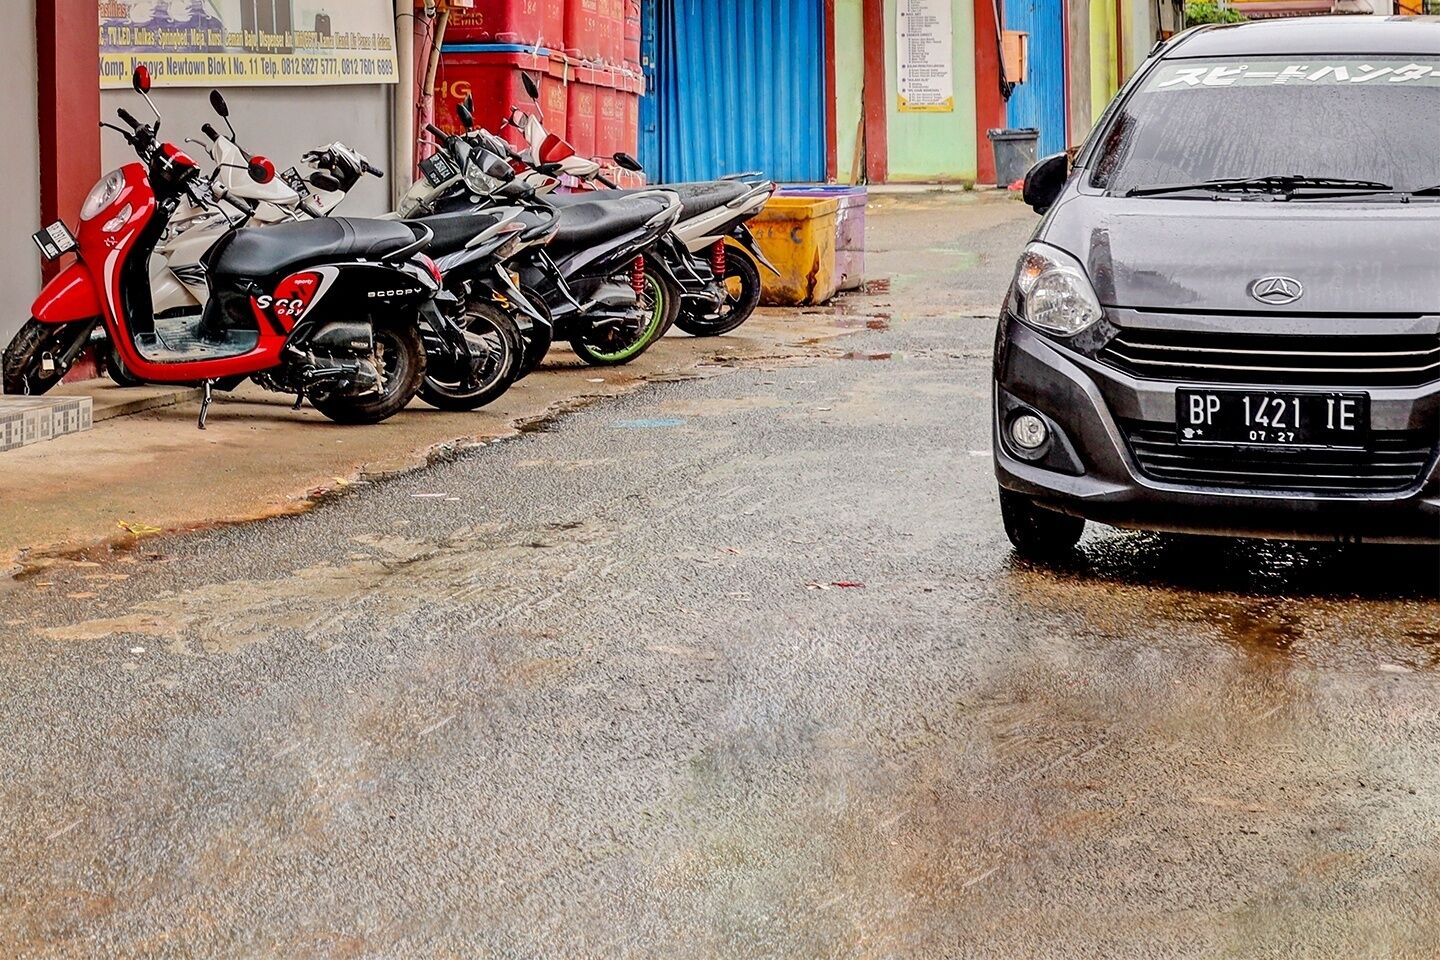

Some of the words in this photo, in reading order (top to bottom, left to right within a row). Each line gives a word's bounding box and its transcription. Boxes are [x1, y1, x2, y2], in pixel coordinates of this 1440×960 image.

[99, 56, 128, 80] Komp.
[166, 56, 205, 75] Newtown
[208, 56, 226, 75] Blok
[234, 57, 247, 75] No.
[250, 57, 258, 75] 11
[261, 57, 280, 78] Telp.
[281, 58, 300, 75] 0812
[341, 58, 358, 75] 0812
[1159, 63, 1440, 87] スピードハンタ
[1189, 394, 1221, 425] BP
[1242, 396, 1300, 428] 1421
[1326, 398, 1356, 431] IE
